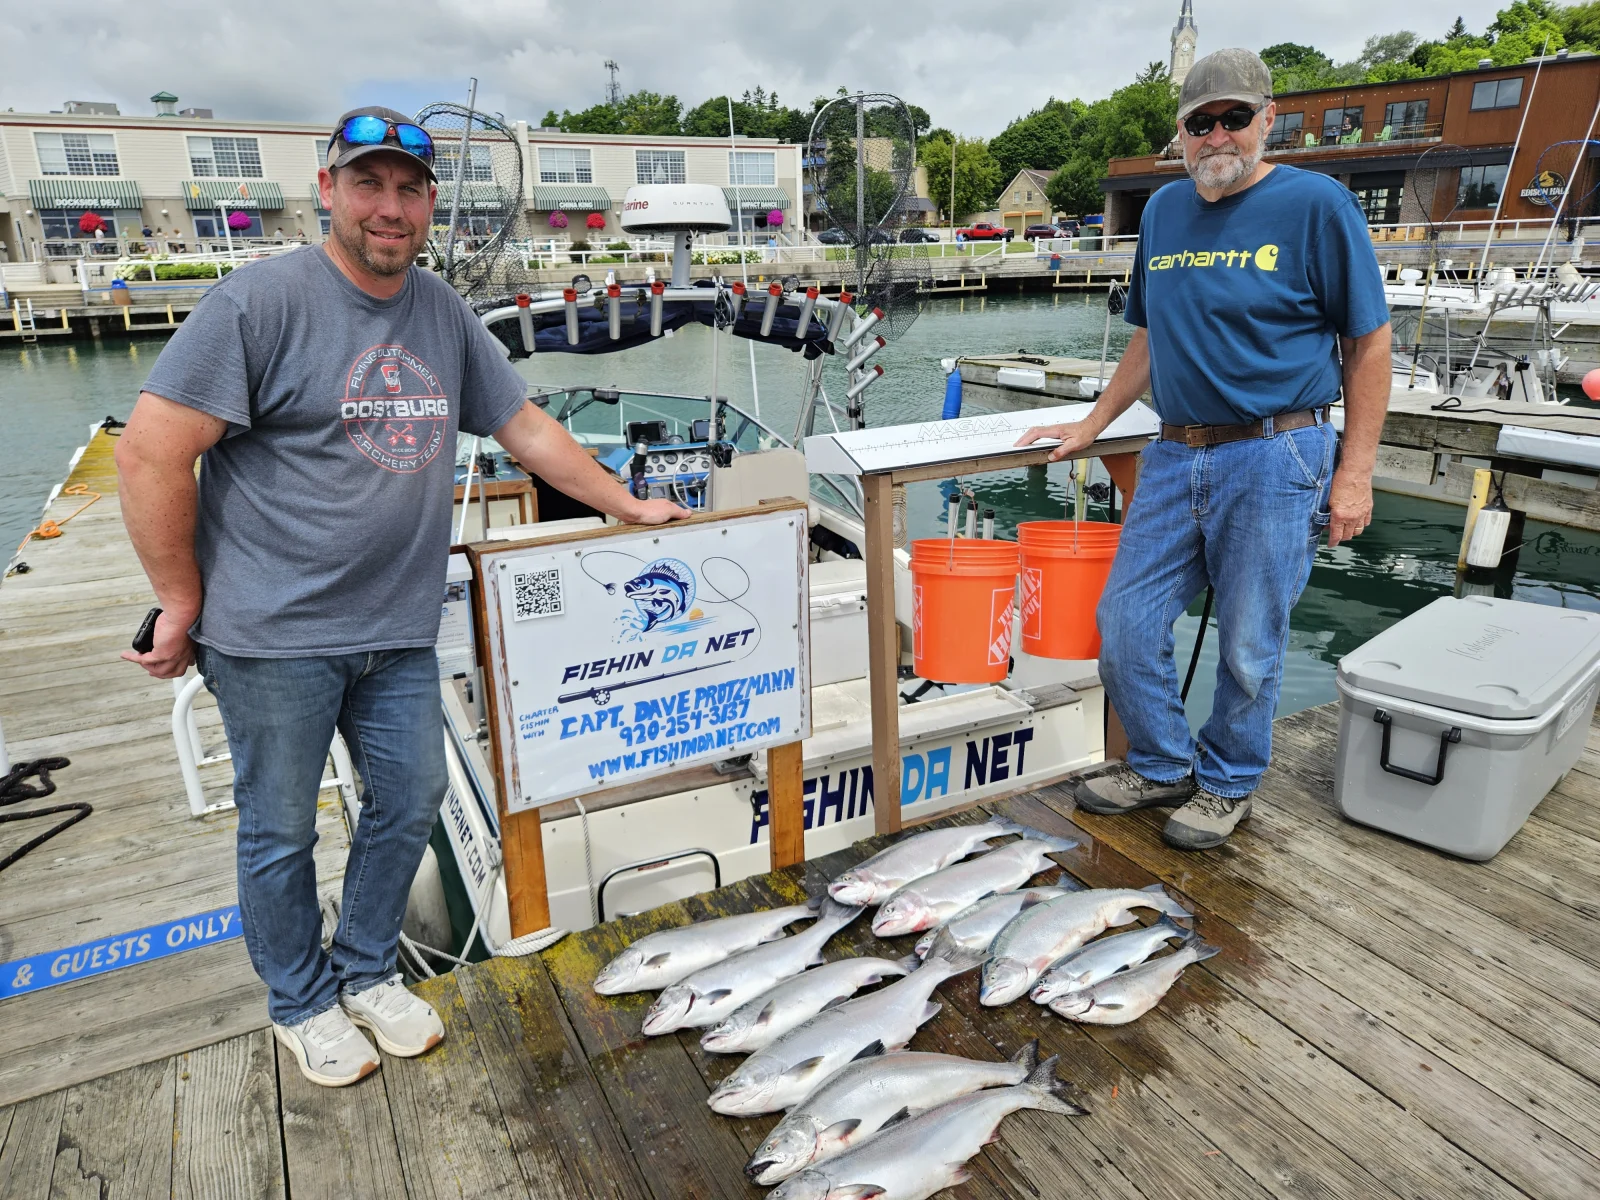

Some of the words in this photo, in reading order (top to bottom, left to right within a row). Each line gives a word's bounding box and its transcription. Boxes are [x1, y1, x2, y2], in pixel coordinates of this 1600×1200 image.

[55, 198, 99, 207] DOCKSIDE
[100, 198, 120, 207] DELI
[1149, 249, 1252, 271] carhartt
[351, 351, 377, 389] FLYING
[377, 348, 437, 387] DUTCHMEN
[341, 398, 449, 420] OOSTBURG
[918, 414, 1012, 439] MAGMA
[353, 434, 417, 469] ARCHERY
[419, 431, 442, 463] TEAM
[561, 649, 655, 685] FISHIN
[661, 639, 699, 664] DA
[704, 627, 756, 655] NET
[519, 705, 559, 722] CHARTER
[560, 704, 625, 741] CAPT.
[634, 690, 691, 723] DAVE
[694, 667, 796, 710] PROTZMANN
[521, 718, 550, 731] FISHIN
[523, 729, 545, 740] WITH
[619, 698, 751, 747] 920-254-3137
[901, 746, 952, 807] DA
[964, 726, 1034, 790] NET
[12, 963, 34, 989] &
[50, 933, 152, 978] GUESTS
[166, 911, 233, 948] ONLY
